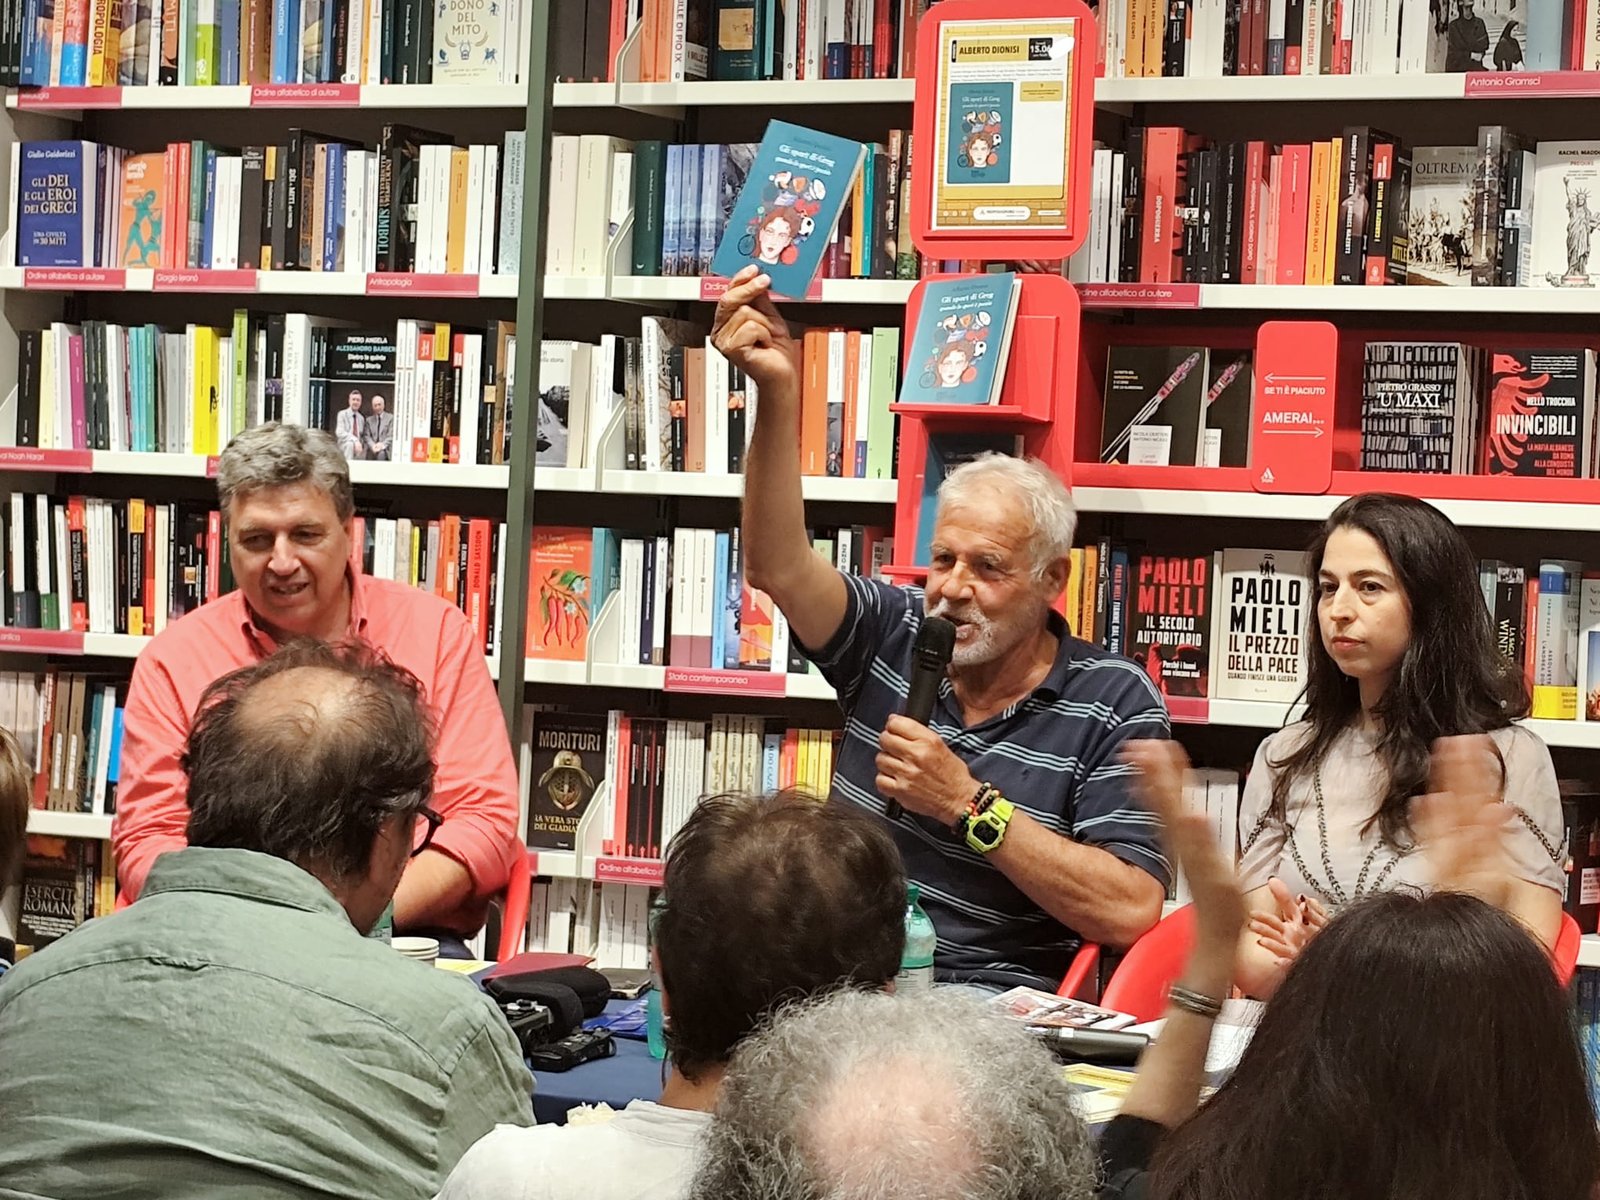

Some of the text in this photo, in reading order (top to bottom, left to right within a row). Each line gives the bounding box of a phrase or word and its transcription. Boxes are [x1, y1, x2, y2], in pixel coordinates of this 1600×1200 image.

[450, 0, 485, 11] DONO
[457, 12, 476, 23] DEL
[452, 24, 481, 36] MITO
[675, 22, 684, 63] DI PIO IX
[959, 45, 1020, 55] ALBERTO DIONISI
[1470, 76, 1541, 86] Antonio Gramsci
[254, 89, 276, 97] Ordine
[277, 88, 311, 97] alfabetico
[318, 89, 340, 97] autore
[32, 174, 68, 188] GLI DEI
[31, 192, 46, 201] GLI
[48, 188, 76, 201] EROI
[24, 201, 76, 214] DEI GRECI
[378, 208, 391, 254] SIMBOLI
[26, 272, 47, 280] Ordine
[48, 272, 78, 280] alfabetico
[85, 273, 106, 281] autore
[156, 273, 178, 283] Giorgio
[369, 278, 413, 288] Antropologia
[1099, 288, 1137, 298] alfabetico
[1146, 289, 1173, 298] autore
[365, 336, 388, 344] ANGELA
[1264, 384, 1326, 395] SE TI È PIACIUTO
[1377, 383, 1442, 391] PIETRO GRASSO
[1395, 393, 1441, 408] MAXI
[1526, 396, 1576, 407] NELLO TROCCHIA
[1263, 412, 1325, 424] AMERAI...
[1496, 413, 1577, 436] INVINCIBILI
[474, 531, 482, 561] SASSOON
[1139, 556, 1206, 586] PAOLO
[1231, 577, 1301, 606] PAOLO
[1137, 586, 1204, 616] MIELI
[1146, 615, 1195, 631] IL SECOLO
[1230, 606, 1299, 635] MIELI
[1136, 631, 1202, 647] AUTORITARIO
[1228, 634, 1299, 655] IL PREZZO
[1228, 654, 1298, 673] DELLA PACE
[668, 673, 748, 685] Storia contemporanea
[1228, 672, 1298, 683] QUANDO FINISCE UNA GUERRA
[539, 731, 600, 751] MORITURI
[767, 745, 775, 766] ALDO
[534, 815, 544, 824] LA
[545, 816, 565, 825] VERA
[534, 823, 547, 831] DEI
[599, 863, 657, 875] Ordine alfabetico
